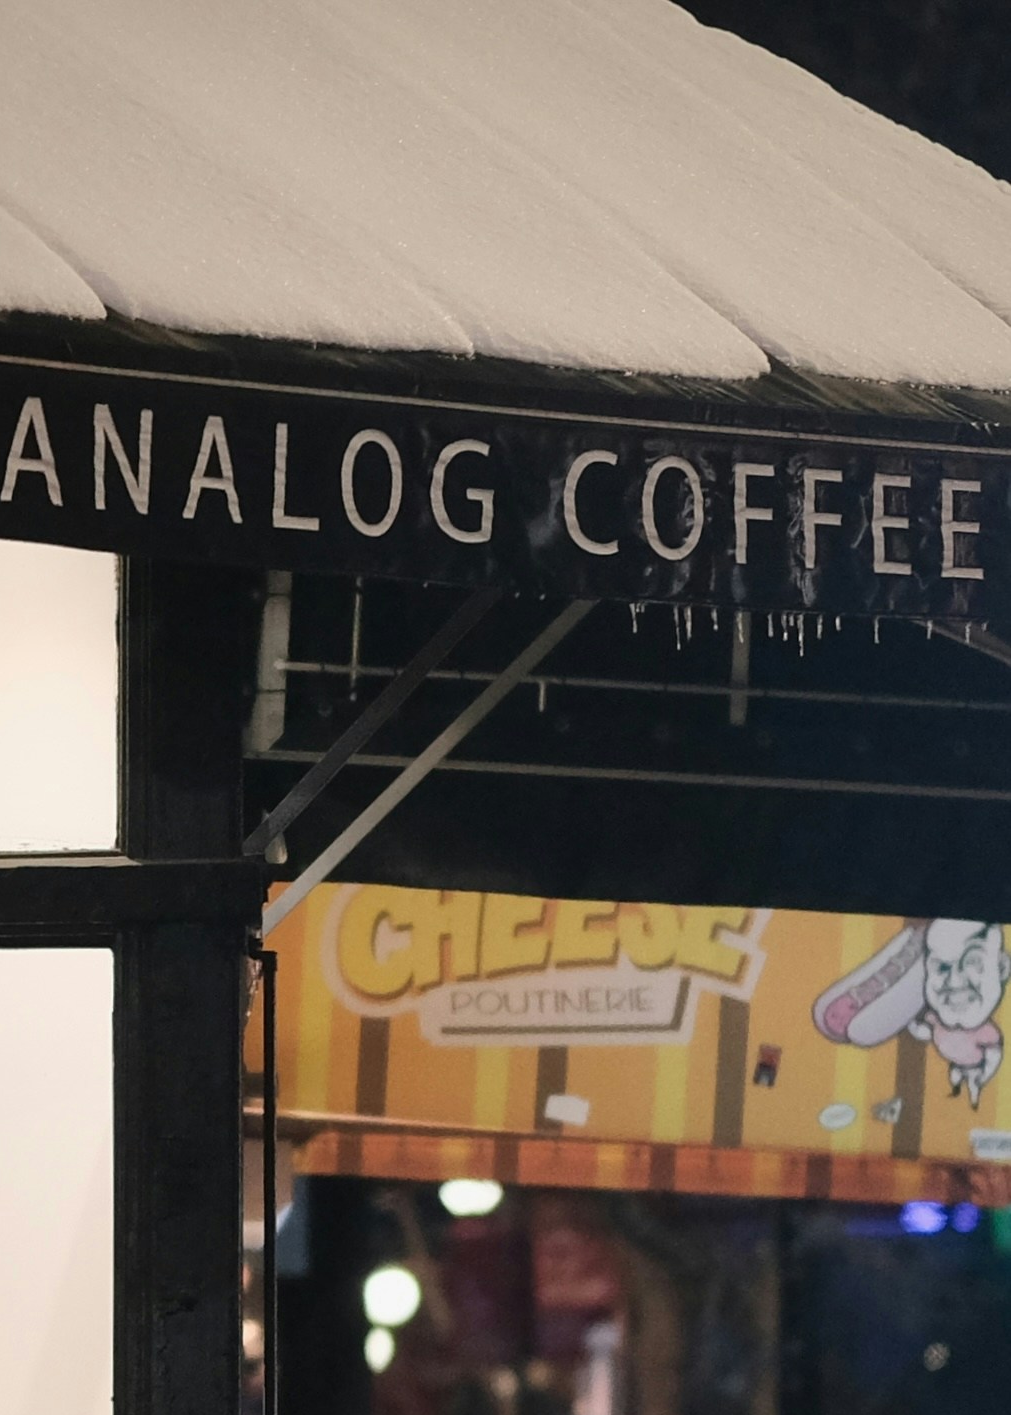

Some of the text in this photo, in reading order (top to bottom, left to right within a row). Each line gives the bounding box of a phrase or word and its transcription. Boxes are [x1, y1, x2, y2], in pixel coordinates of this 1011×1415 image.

[562, 449, 987, 582] COFFEE
[337, 885, 750, 1000] CHEESE
[450, 984, 655, 1016] POUTINERIE
